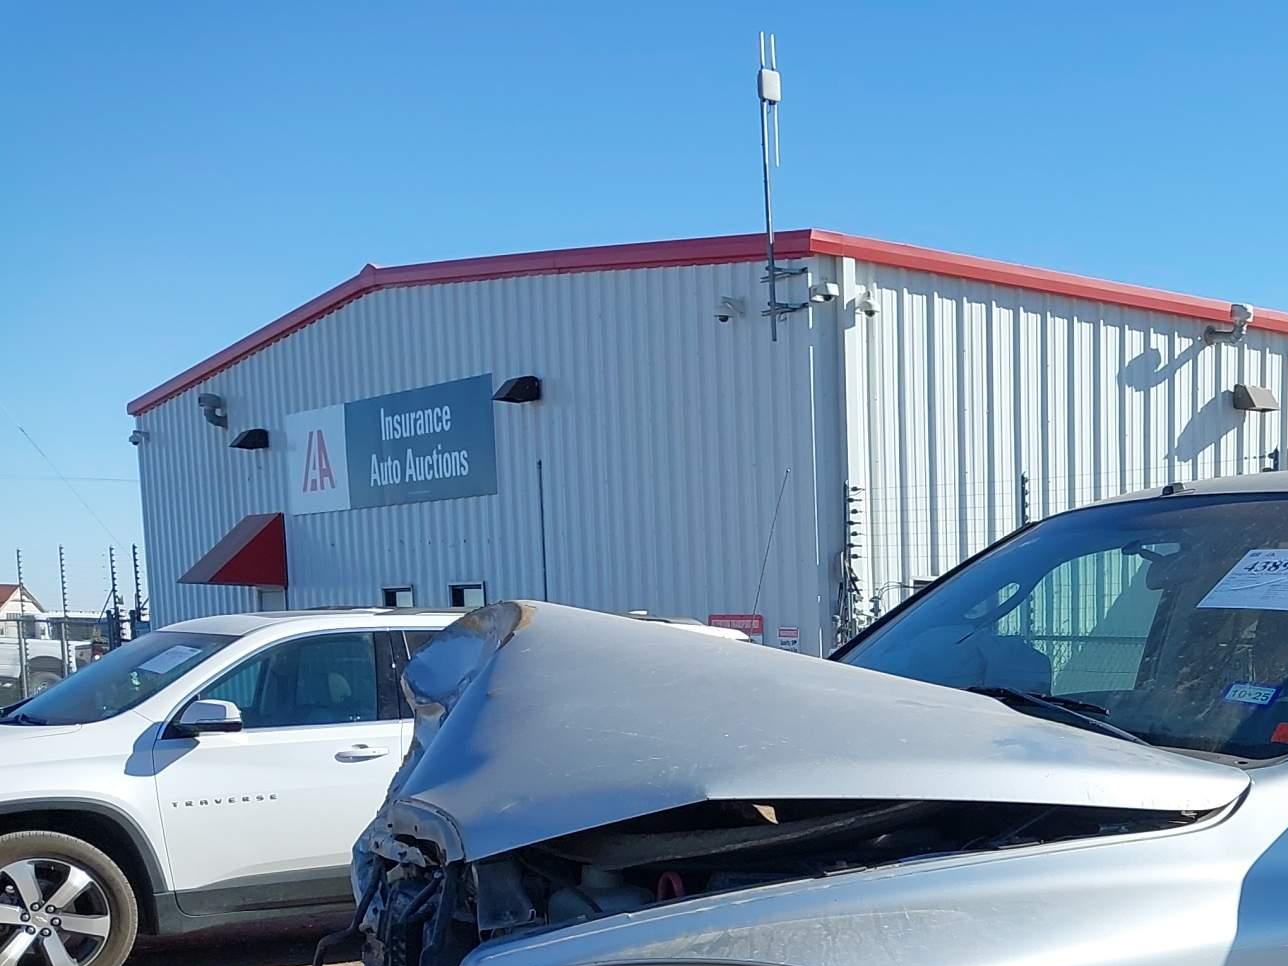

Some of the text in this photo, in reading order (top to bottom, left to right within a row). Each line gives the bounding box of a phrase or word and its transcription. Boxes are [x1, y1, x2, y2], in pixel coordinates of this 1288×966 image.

[380, 405, 451, 441] Insurance
[370, 444, 469, 487] Auto Auctions
[172, 793, 278, 808] TRAVERSE
